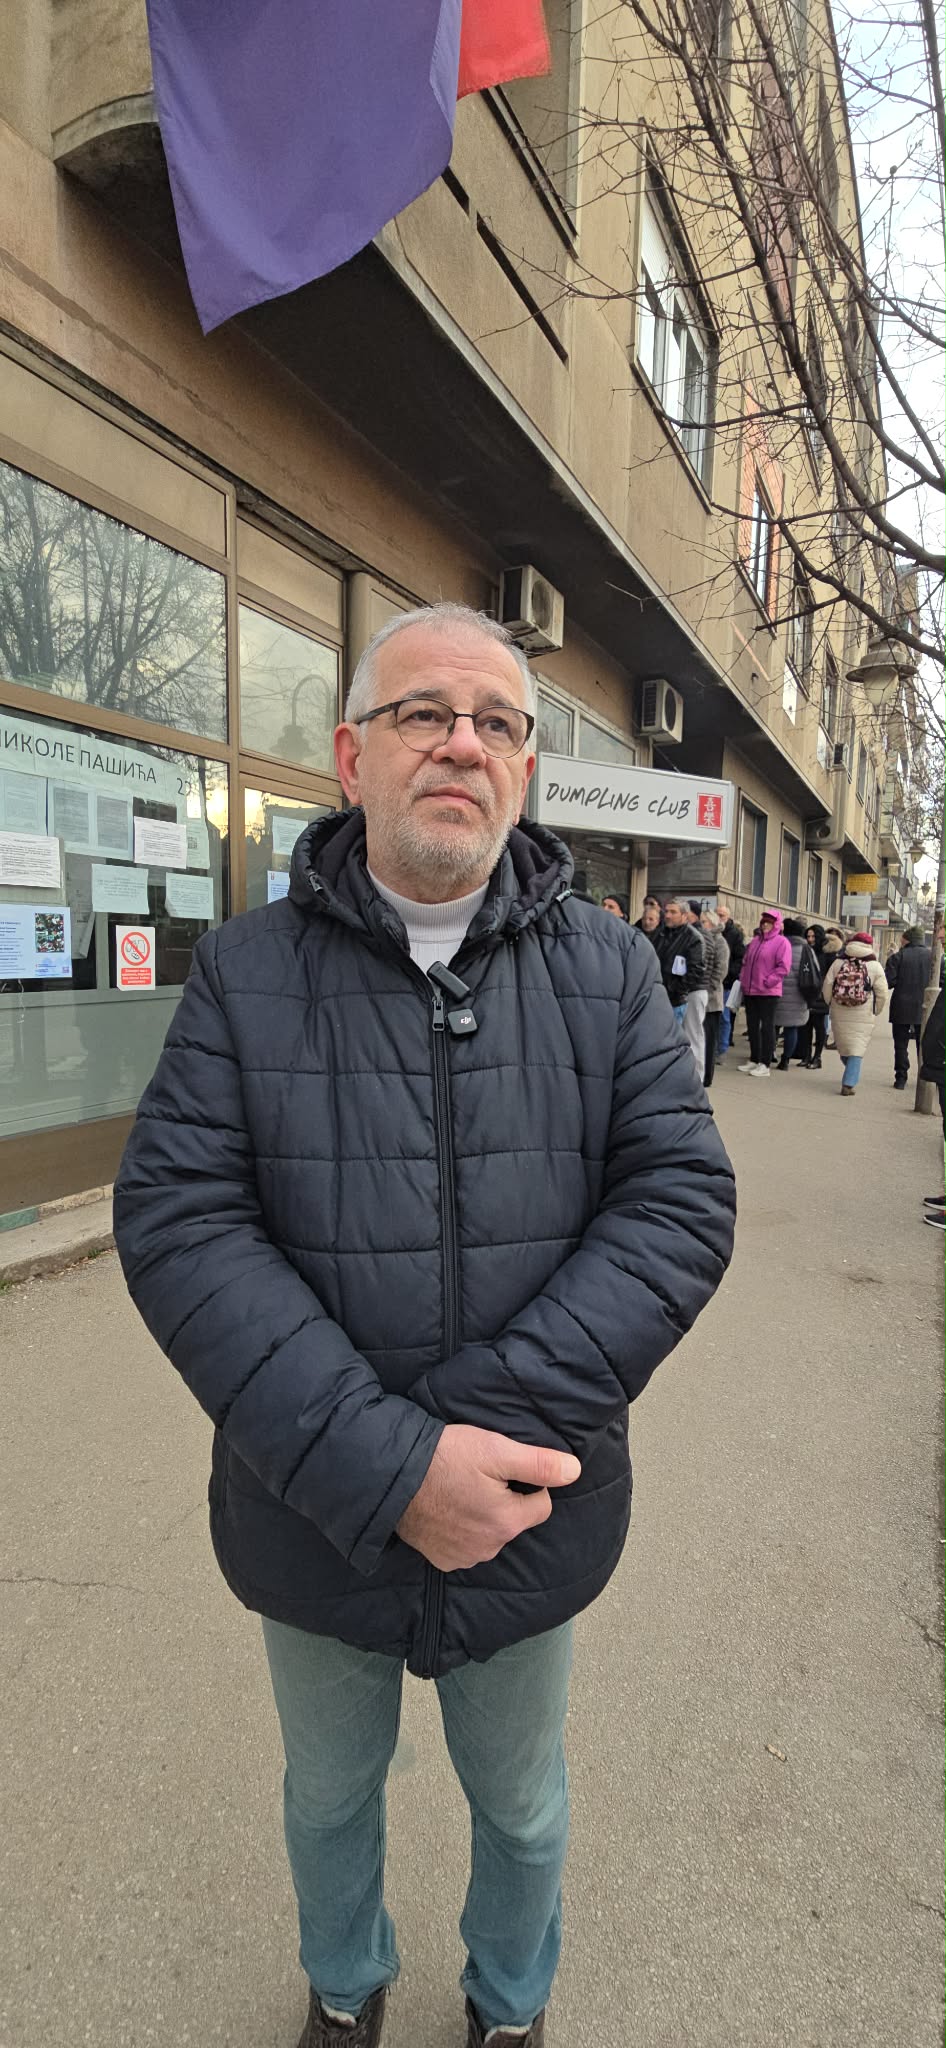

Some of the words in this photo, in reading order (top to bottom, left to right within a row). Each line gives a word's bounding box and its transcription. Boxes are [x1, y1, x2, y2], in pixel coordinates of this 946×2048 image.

[0, 729, 75, 763] ИКОЛЕ
[80, 749, 157, 784] ПАШИЋА
[546, 782, 640, 812] DUMPLING
[647, 795, 691, 820] CLUB
